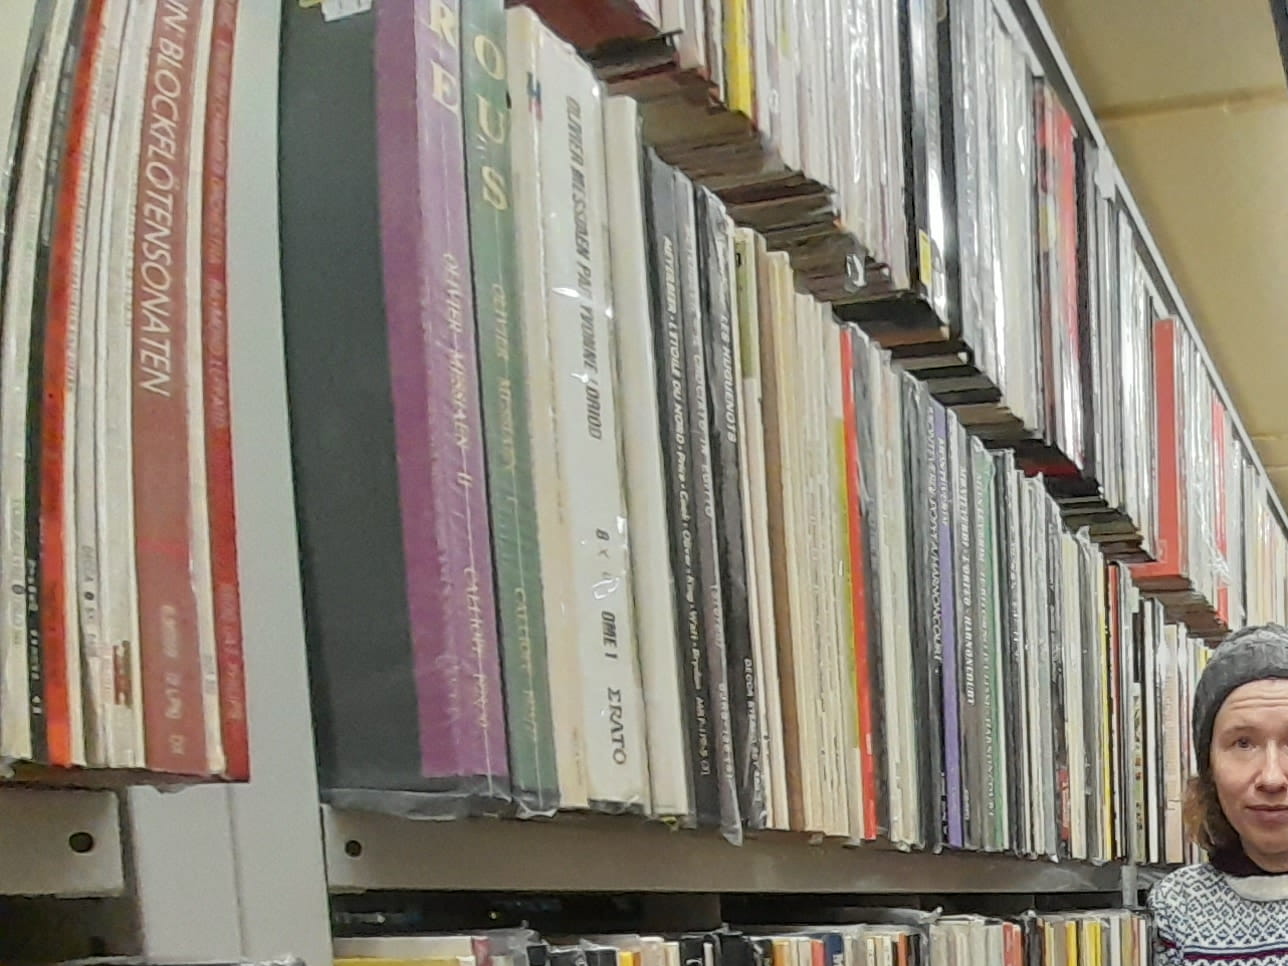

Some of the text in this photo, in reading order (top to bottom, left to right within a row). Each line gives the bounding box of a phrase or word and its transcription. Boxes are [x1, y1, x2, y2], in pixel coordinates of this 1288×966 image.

[140, 37, 186, 398] BLOCKFLÖTENSONATEN
[565, 95, 584, 167] OLIVIER
[580, 303, 599, 376] YVONNE
[673, 403, 688, 445] NORD
